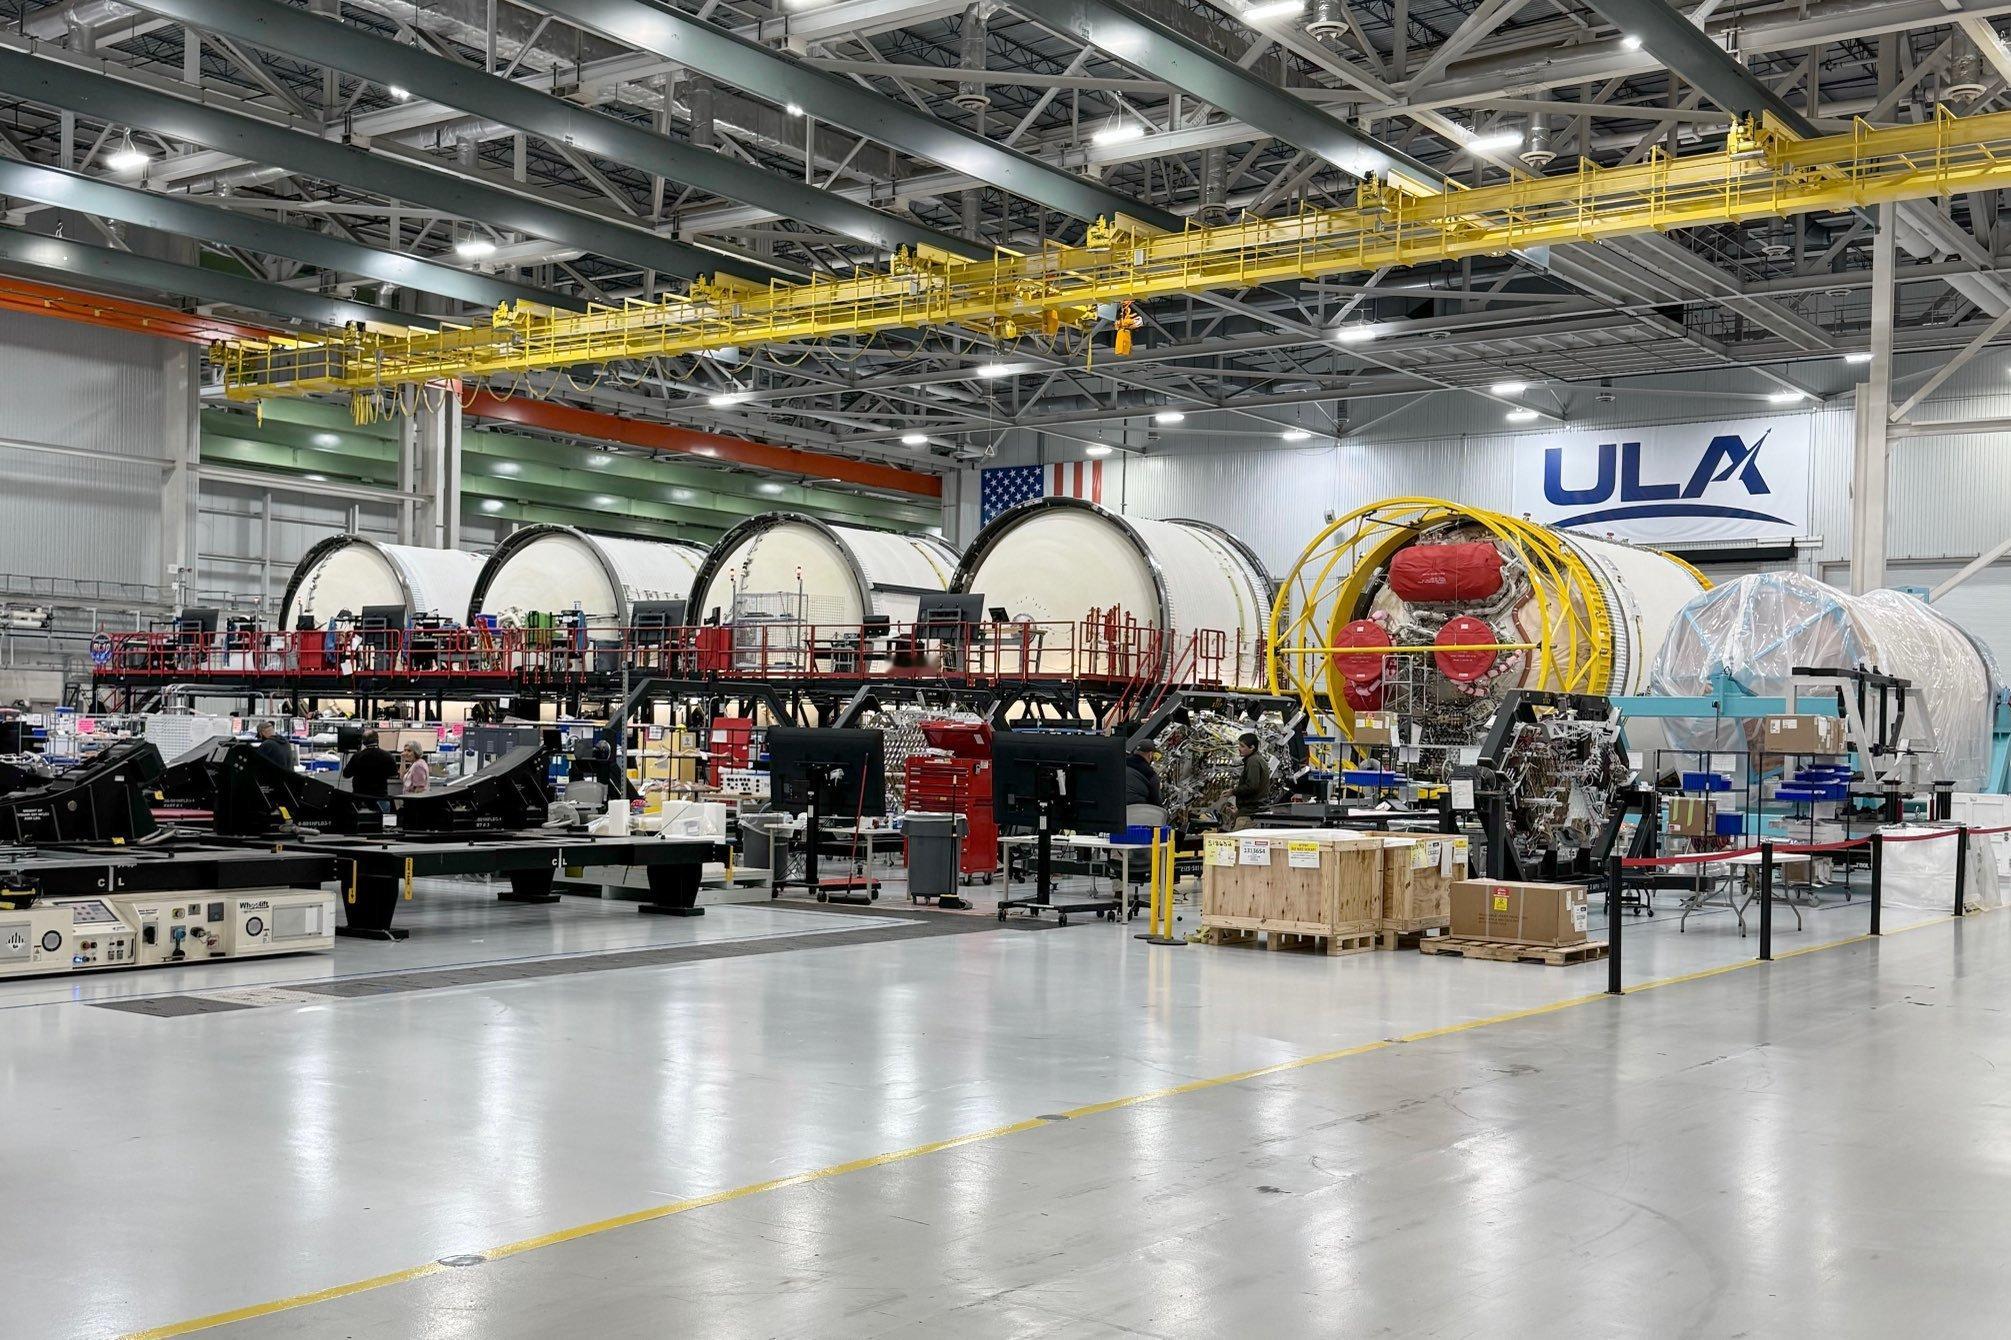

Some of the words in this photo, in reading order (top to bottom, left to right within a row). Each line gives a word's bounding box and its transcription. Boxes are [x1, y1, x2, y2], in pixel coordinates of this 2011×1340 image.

[1544, 427, 1772, 506] ULA
[97, 878, 105, 887] C
[118, 877, 125, 886] L
